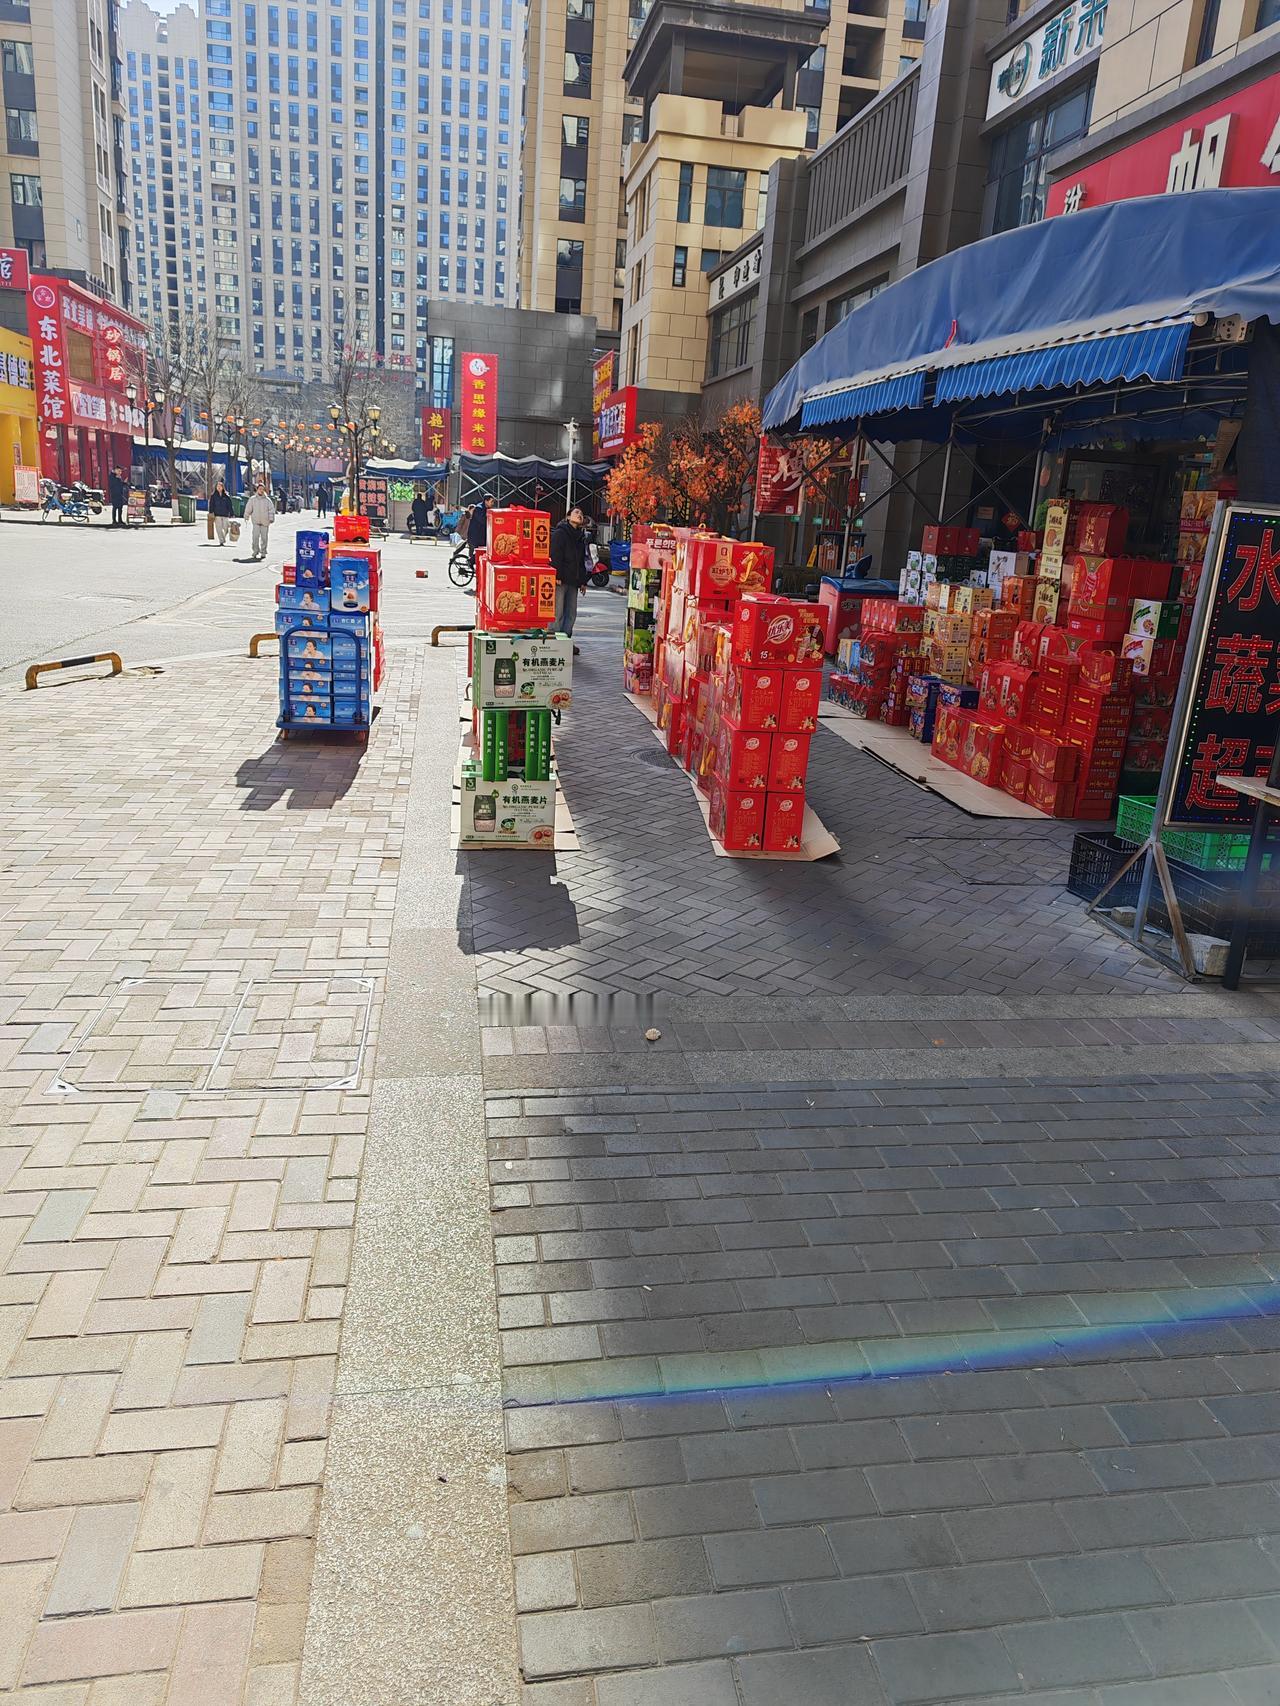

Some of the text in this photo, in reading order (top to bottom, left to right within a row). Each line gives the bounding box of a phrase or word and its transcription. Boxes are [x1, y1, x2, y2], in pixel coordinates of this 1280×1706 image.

[38, 316, 65, 419] 东北菜馆
[104, 329, 123, 381] 砂锅居
[427, 412, 445, 452] 超市
[472, 379, 486, 448] 香思缘米线
[522, 657, 565, 667] 有机燕麦片
[502, 795, 547, 805] 有机燕麦片
